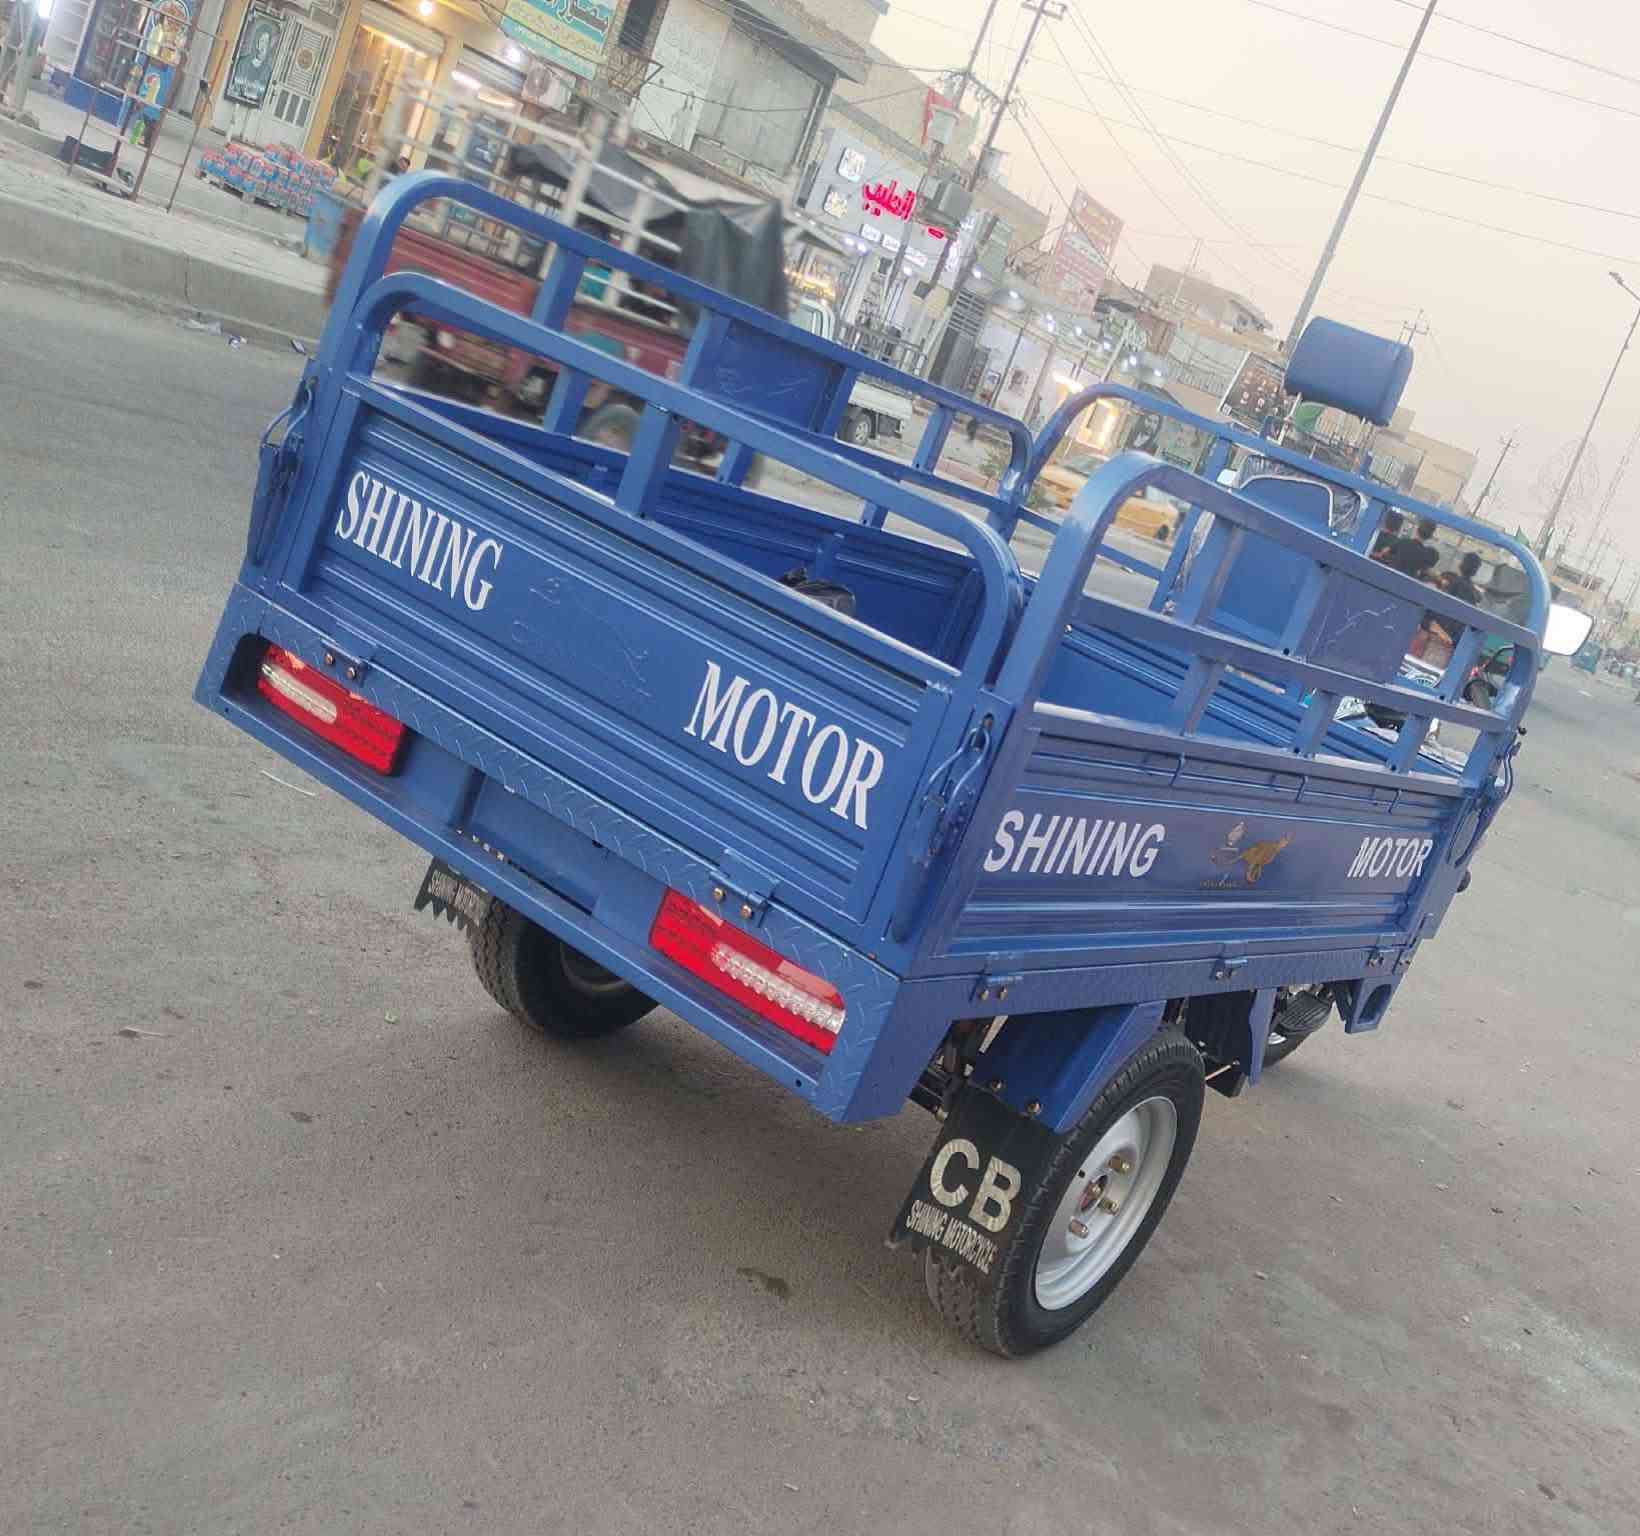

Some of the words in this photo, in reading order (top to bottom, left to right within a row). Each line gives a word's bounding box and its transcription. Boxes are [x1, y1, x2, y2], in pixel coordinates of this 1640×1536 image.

[335, 471, 503, 611] SHINING
[683, 659, 884, 830] MOTOR
[983, 809, 1166, 877] SHINING
[1347, 837, 1433, 878] MOTOR
[930, 1138, 1022, 1233] CB
